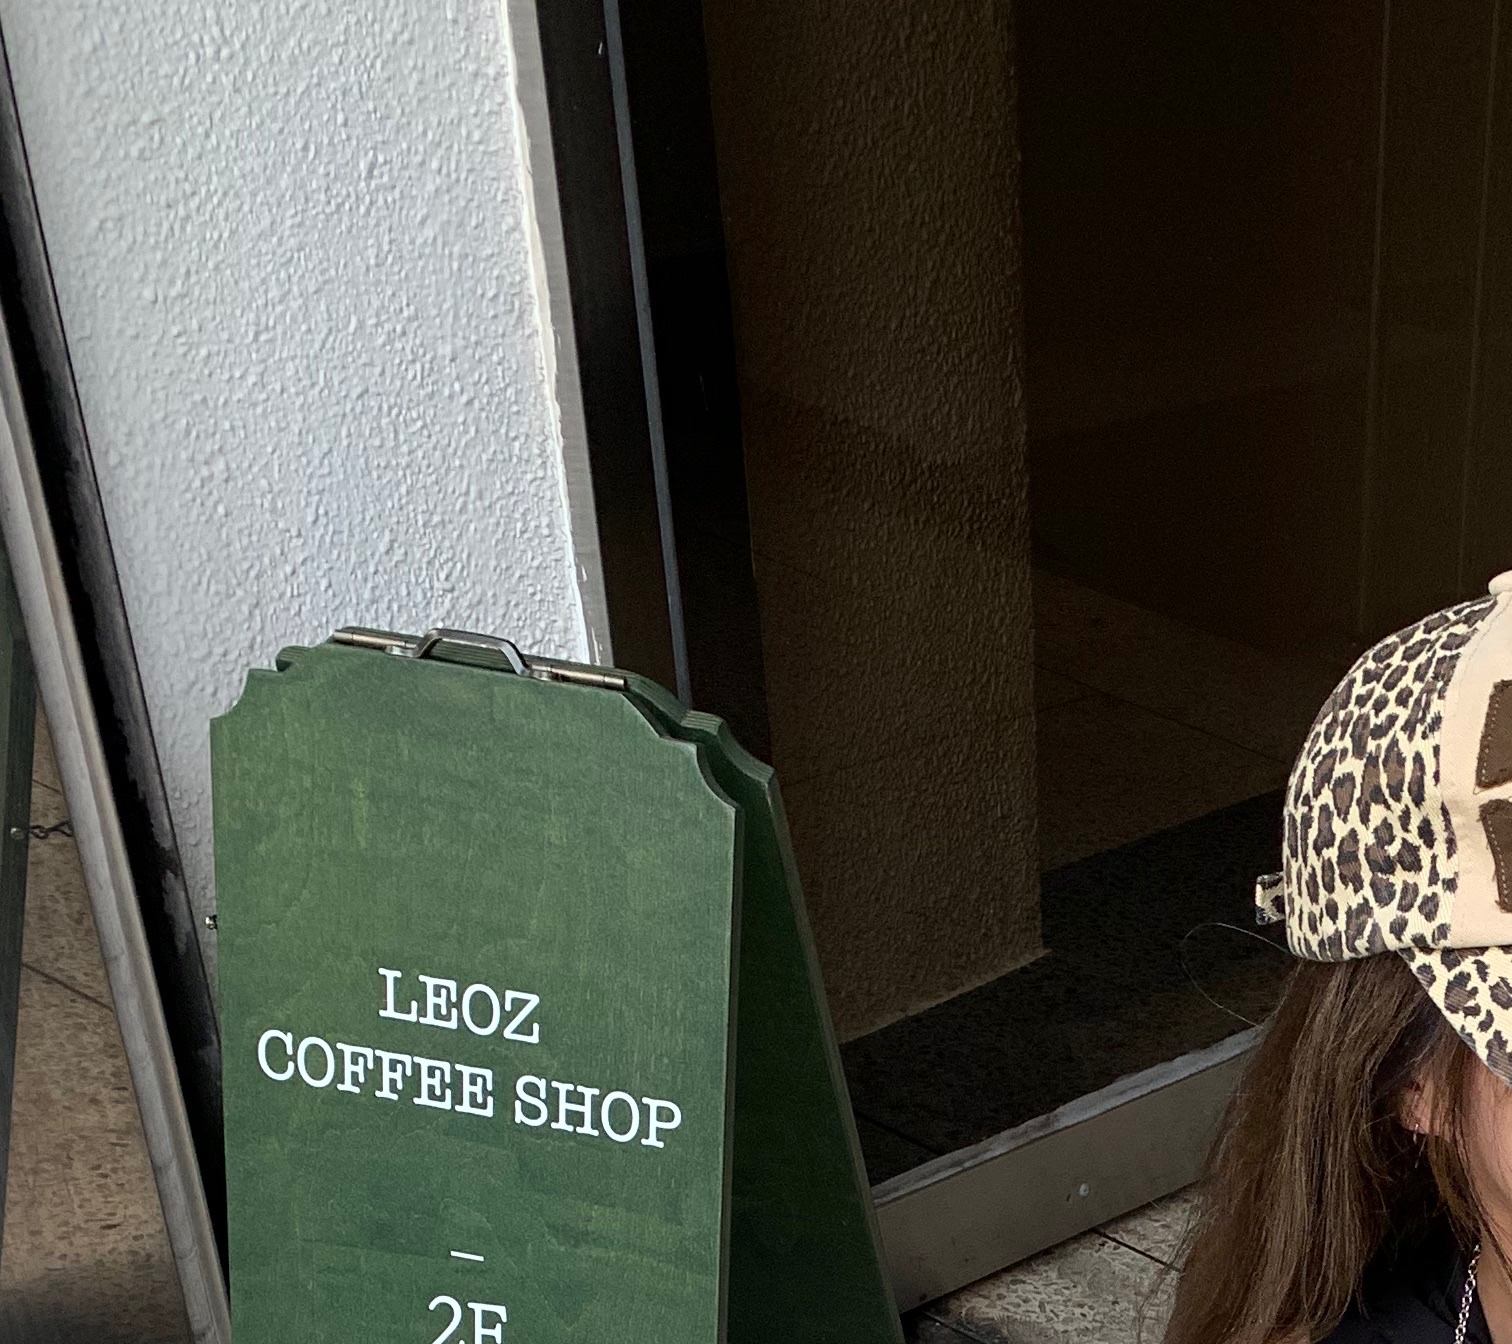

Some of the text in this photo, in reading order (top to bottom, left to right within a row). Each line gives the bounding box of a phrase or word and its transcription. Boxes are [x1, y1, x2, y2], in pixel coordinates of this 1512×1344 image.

[378, 967, 541, 1044] LEOZ
[256, 1029, 683, 1149] COFFEE SHOP
